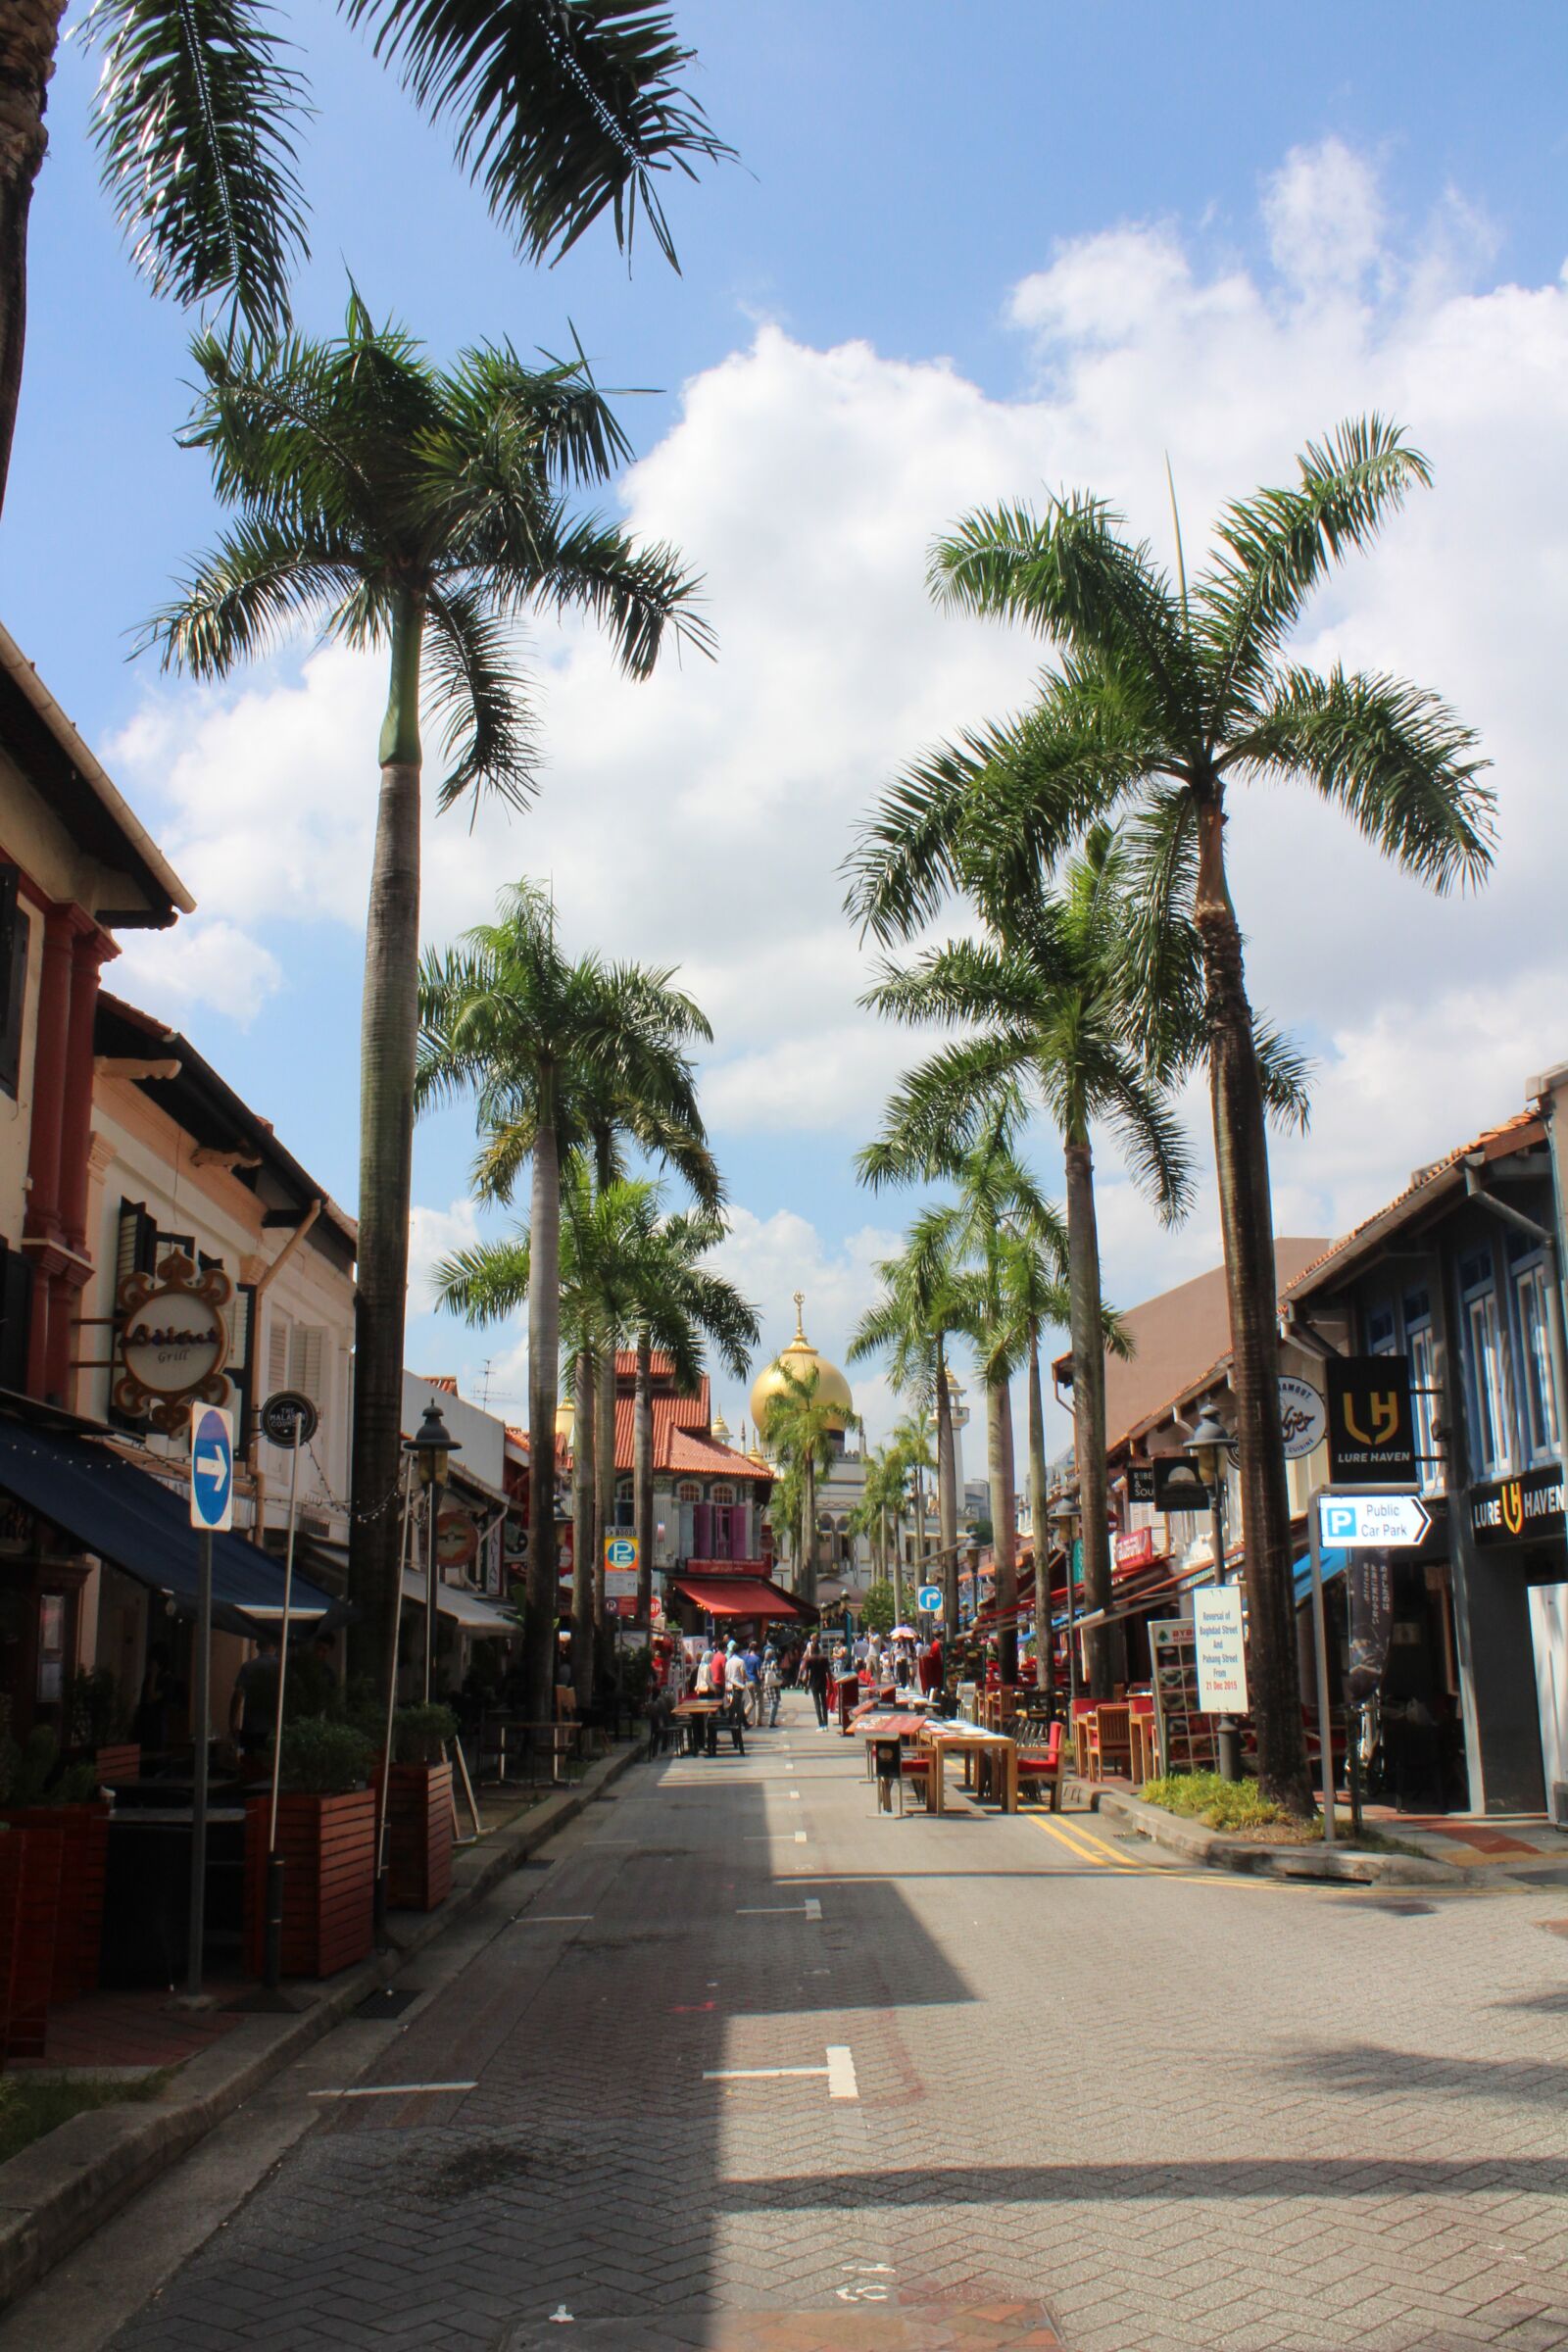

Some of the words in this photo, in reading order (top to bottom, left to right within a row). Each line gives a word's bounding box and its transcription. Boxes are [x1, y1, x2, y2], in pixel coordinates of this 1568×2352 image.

[157, 1349, 190, 1363] Grill
[1338, 1453, 1367, 1463] LURE
[1371, 1451, 1410, 1462] HAVEN
[1366, 1504, 1399, 1517] Public
[1474, 1499, 1501, 1528] LURE
[1523, 1484, 1565, 1518] HAVEN
[1331, 1510, 1351, 1534] P
[1361, 1524, 1379, 1537] Car
[1383, 1523, 1407, 1537] Park
[1202, 1611, 1224, 1621] Reversal
[1225, 1610, 1231, 1620] of
[1200, 1626, 1221, 1638] Baghdad
[1222, 1625, 1238, 1635] Street
[1213, 1640, 1223, 1648] And
[1202, 1654, 1221, 1665] Pahang
[1222, 1654, 1238, 1663] Street
[1213, 1668, 1226, 1678] From
[1205, 1681, 1212, 1690] 21
[1213, 1681, 1223, 1690] Dec
[1224, 1681, 1238, 1690] 2015
